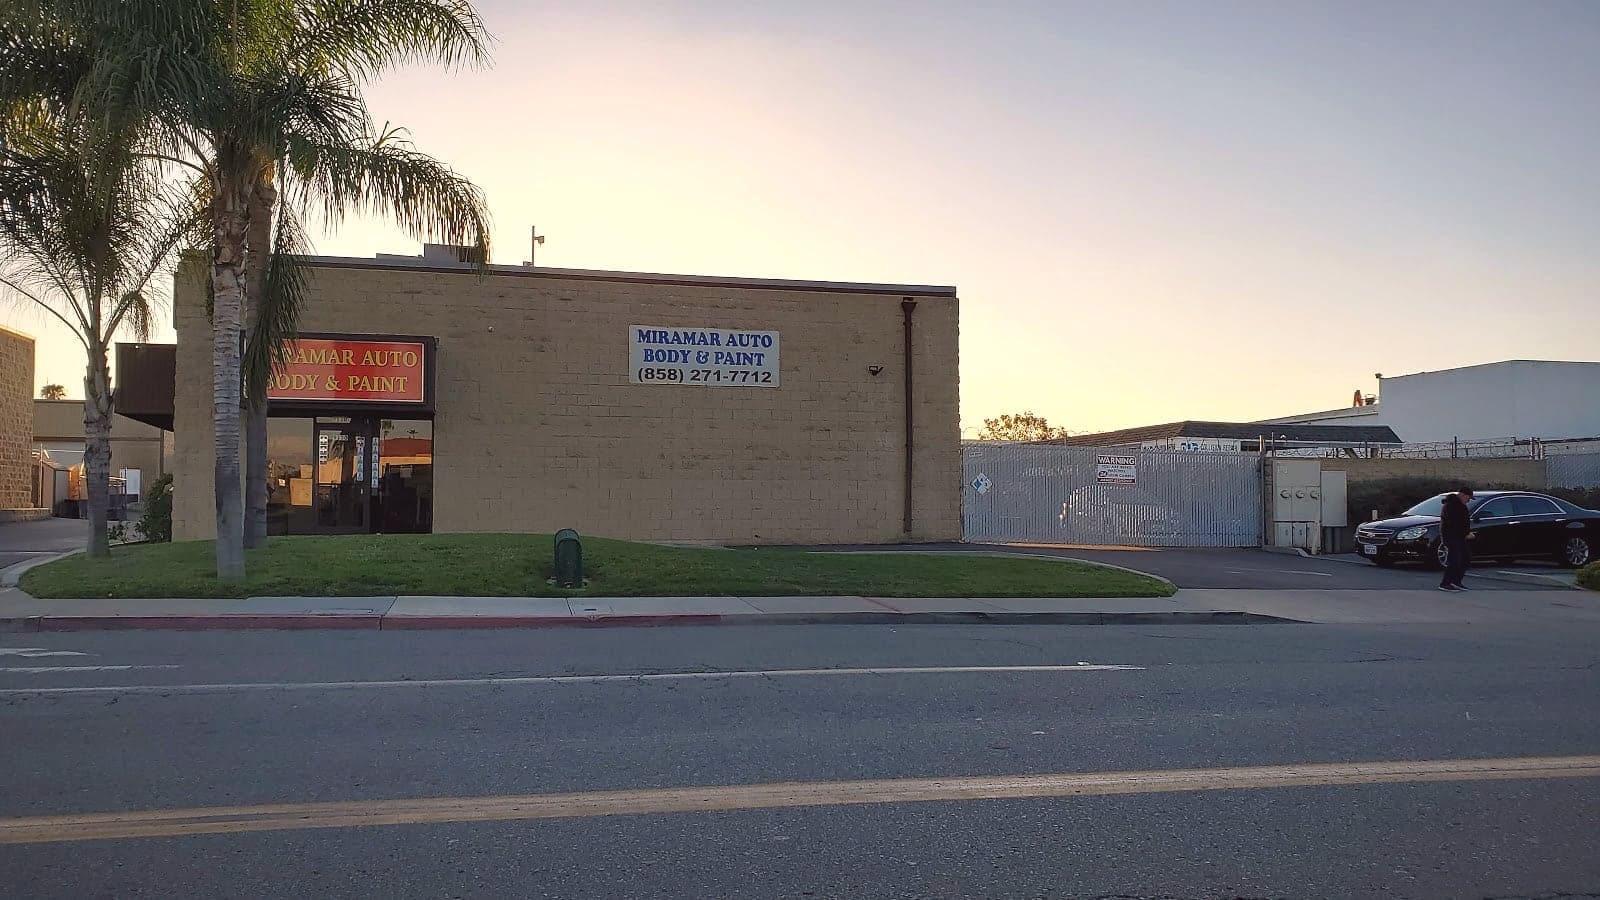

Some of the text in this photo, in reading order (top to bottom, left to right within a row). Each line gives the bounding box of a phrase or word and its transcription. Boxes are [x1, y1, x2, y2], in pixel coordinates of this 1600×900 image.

[637, 329, 773, 348] MIRAMAR AUTO
[271, 348, 418, 367] AMAR AUTO
[643, 348, 765, 366] BODY & PAINT
[325, 375, 342, 391] &
[348, 375, 408, 393] PAINT
[638, 367, 772, 383] (858) 271-7712
[1098, 456, 1135, 465] WARNING
